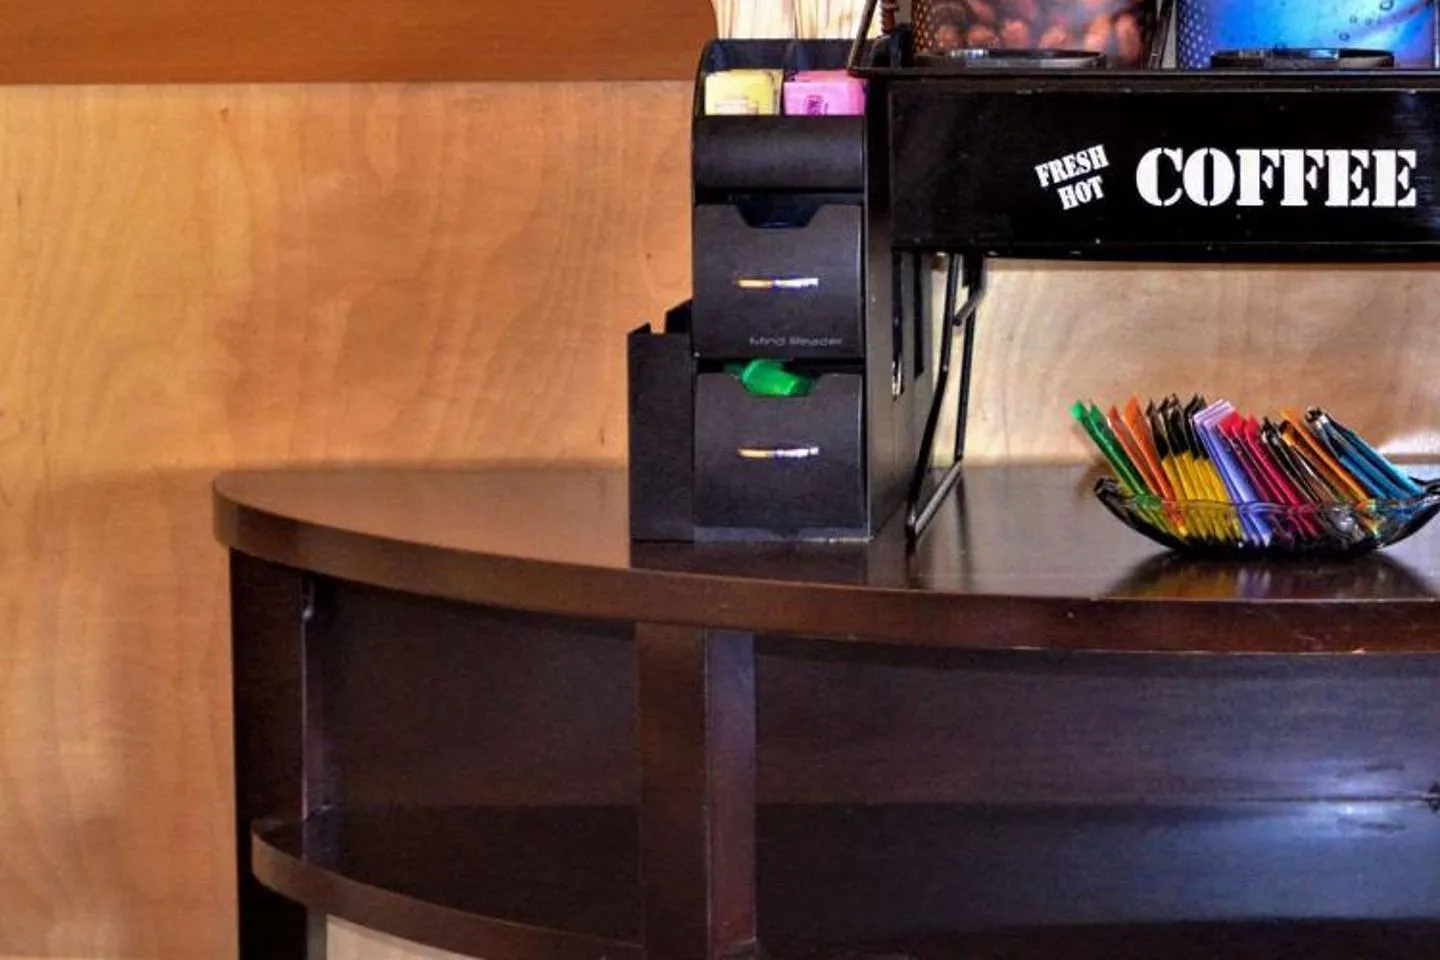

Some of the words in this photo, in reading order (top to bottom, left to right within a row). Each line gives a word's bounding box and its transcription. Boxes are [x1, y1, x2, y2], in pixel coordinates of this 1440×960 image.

[1034, 144, 1110, 188] FRESH
[1135, 146, 1417, 208] COFFEE
[1057, 175, 1105, 211] HOT
